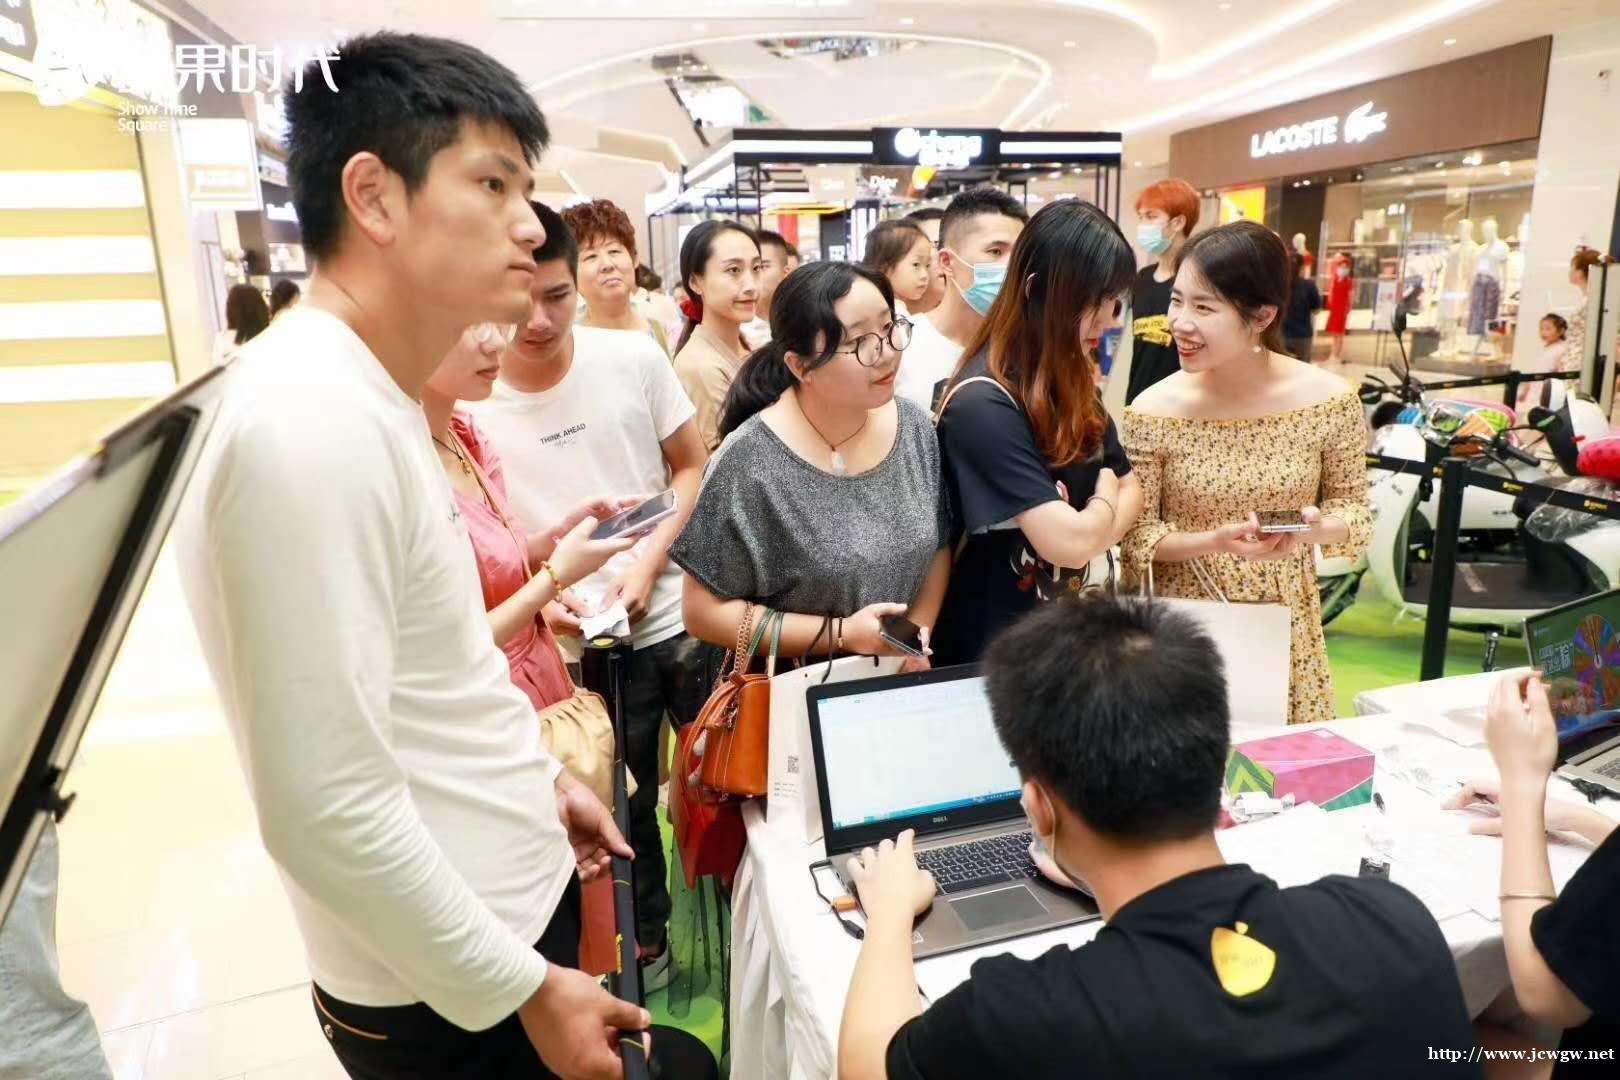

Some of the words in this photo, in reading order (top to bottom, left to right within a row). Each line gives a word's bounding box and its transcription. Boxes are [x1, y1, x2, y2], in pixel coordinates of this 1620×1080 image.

[1250, 116, 1339, 158] LACOSTE
[540, 432, 561, 445] THINK
[563, 423, 586, 437] AHEAD
